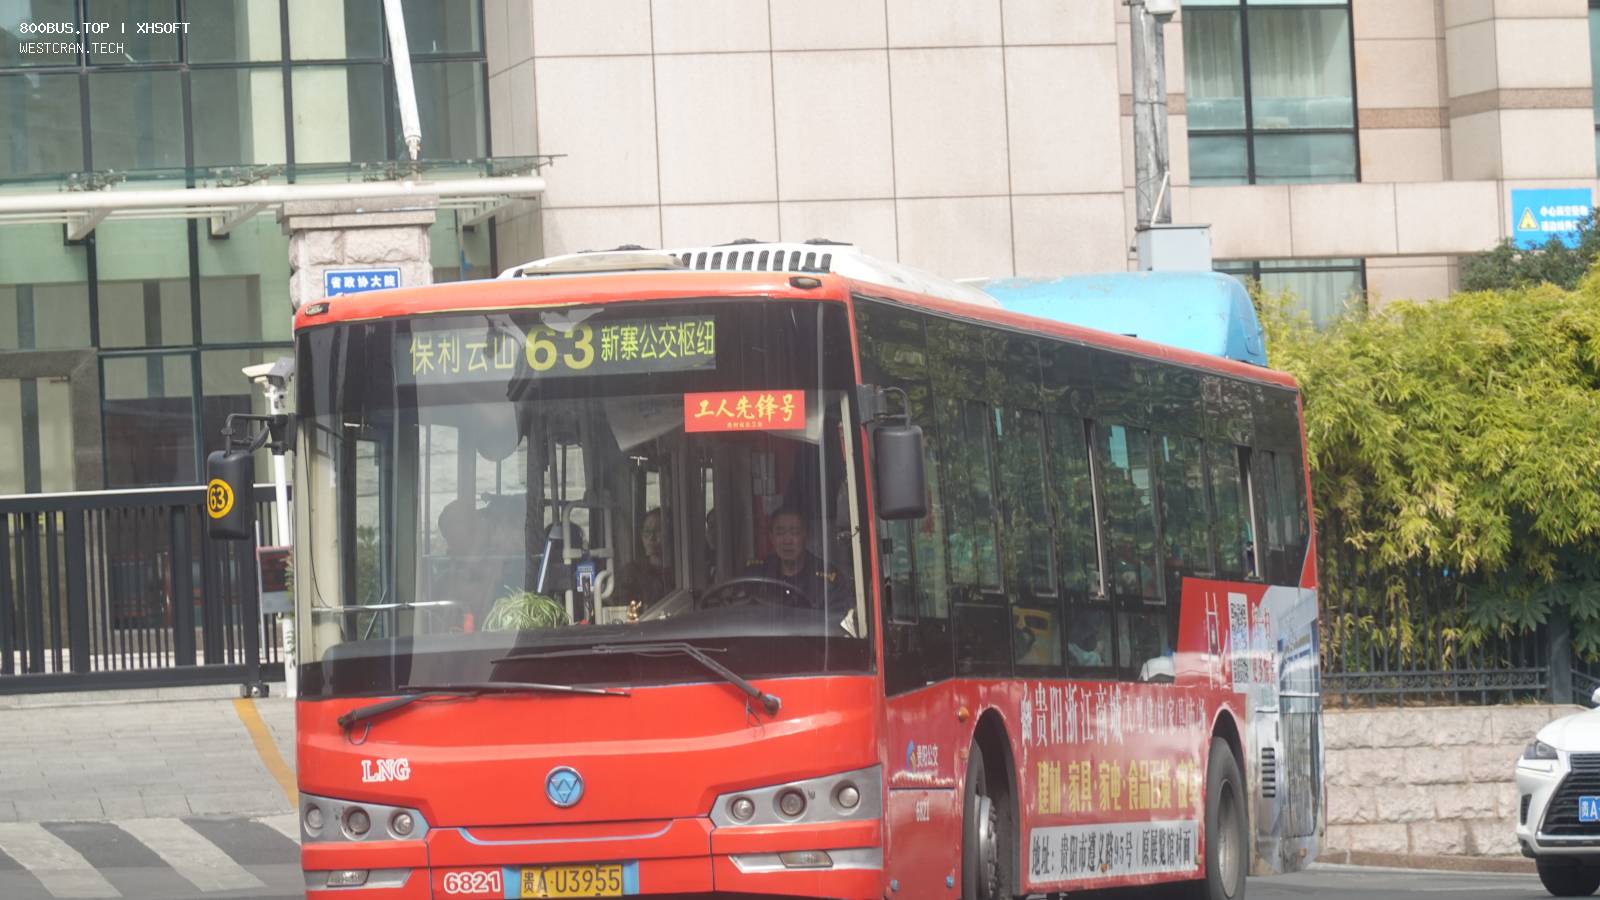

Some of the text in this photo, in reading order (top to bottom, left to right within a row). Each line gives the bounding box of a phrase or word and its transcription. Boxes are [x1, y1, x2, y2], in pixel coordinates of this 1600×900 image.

[331, 275, 396, 289] 省政协大院
[409, 320, 715, 376] 保利云山 63 新寨公交枢纽
[694, 393, 795, 424] 工人先锋号
[209, 487, 226, 509] 63
[361, 758, 411, 783] LNG
[444, 871, 501, 894] 6821
